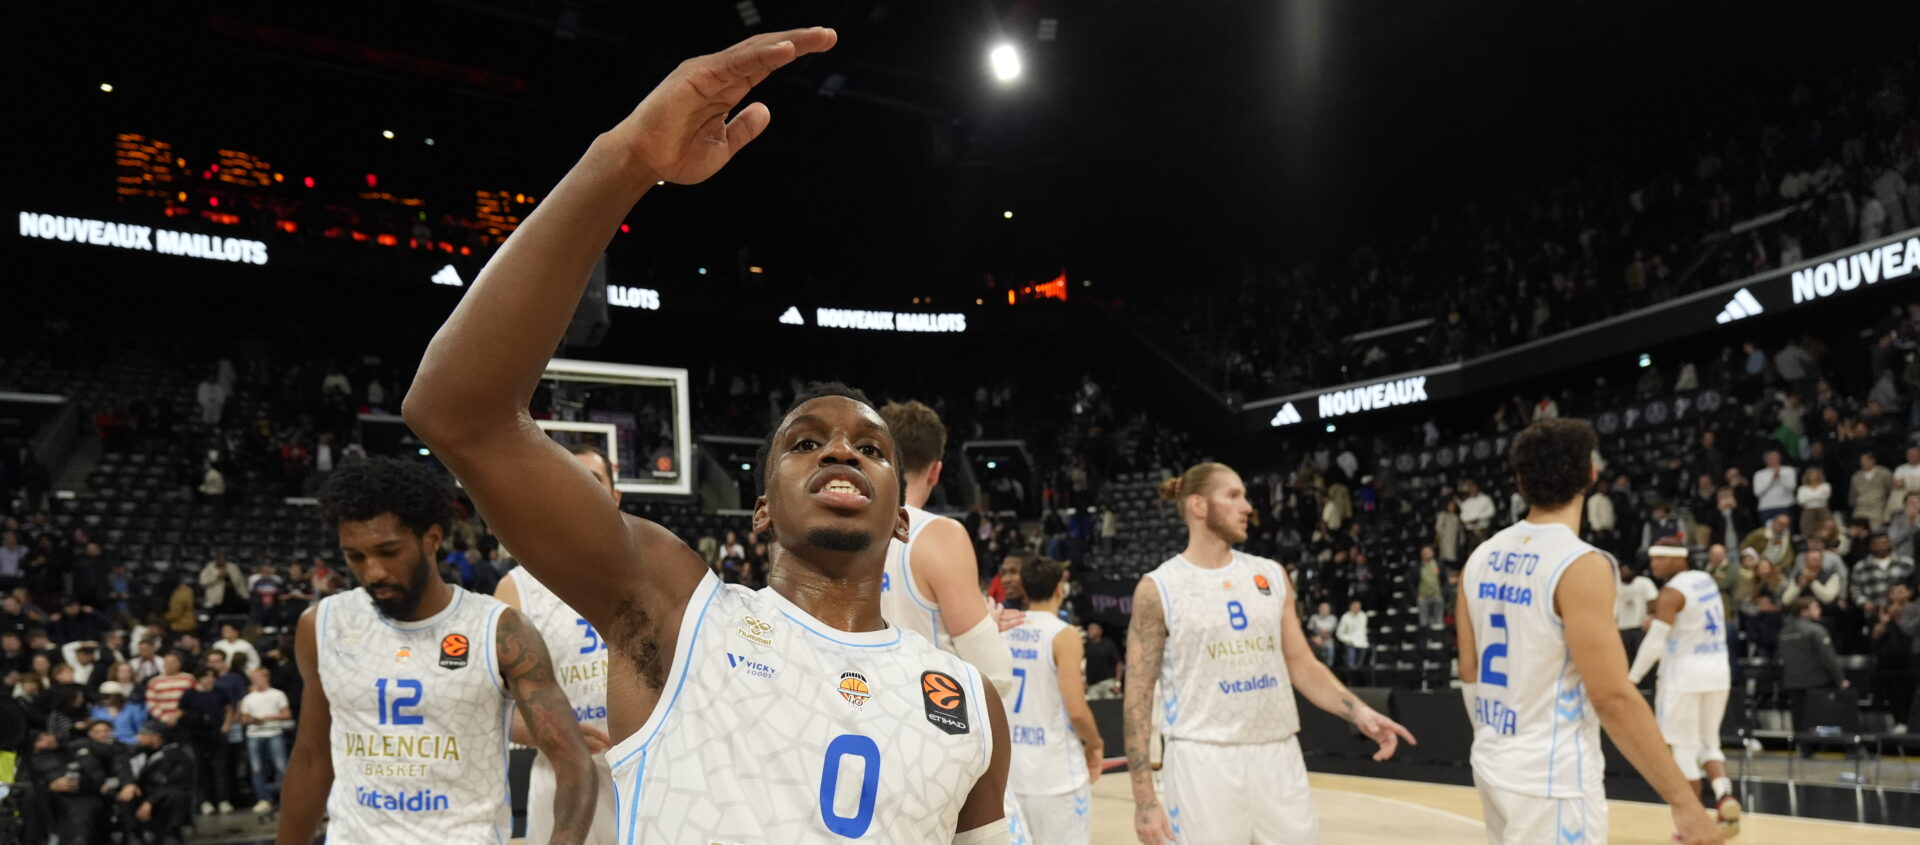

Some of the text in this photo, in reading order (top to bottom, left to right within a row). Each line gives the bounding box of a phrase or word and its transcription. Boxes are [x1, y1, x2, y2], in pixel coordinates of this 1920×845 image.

[19, 211, 268, 265] NOUVEAUX MAILLOTS
[816, 307, 967, 332] NOUVEAUX MAILLOTS
[1318, 375, 1428, 419] NOUVEAUX
[1227, 600, 1248, 630] 8
[738, 627, 773, 646] hummel
[1480, 613, 1508, 688] 2
[746, 660, 776, 673] VICKY
[1012, 667, 1026, 714] 7
[1218, 673, 1278, 694] Vitaldin
[375, 678, 424, 725] 12
[928, 713, 966, 729] ETIHAD
[345, 732, 460, 761] VALENCIA
[364, 763, 427, 777] BASKET
[819, 734, 881, 839] 0
